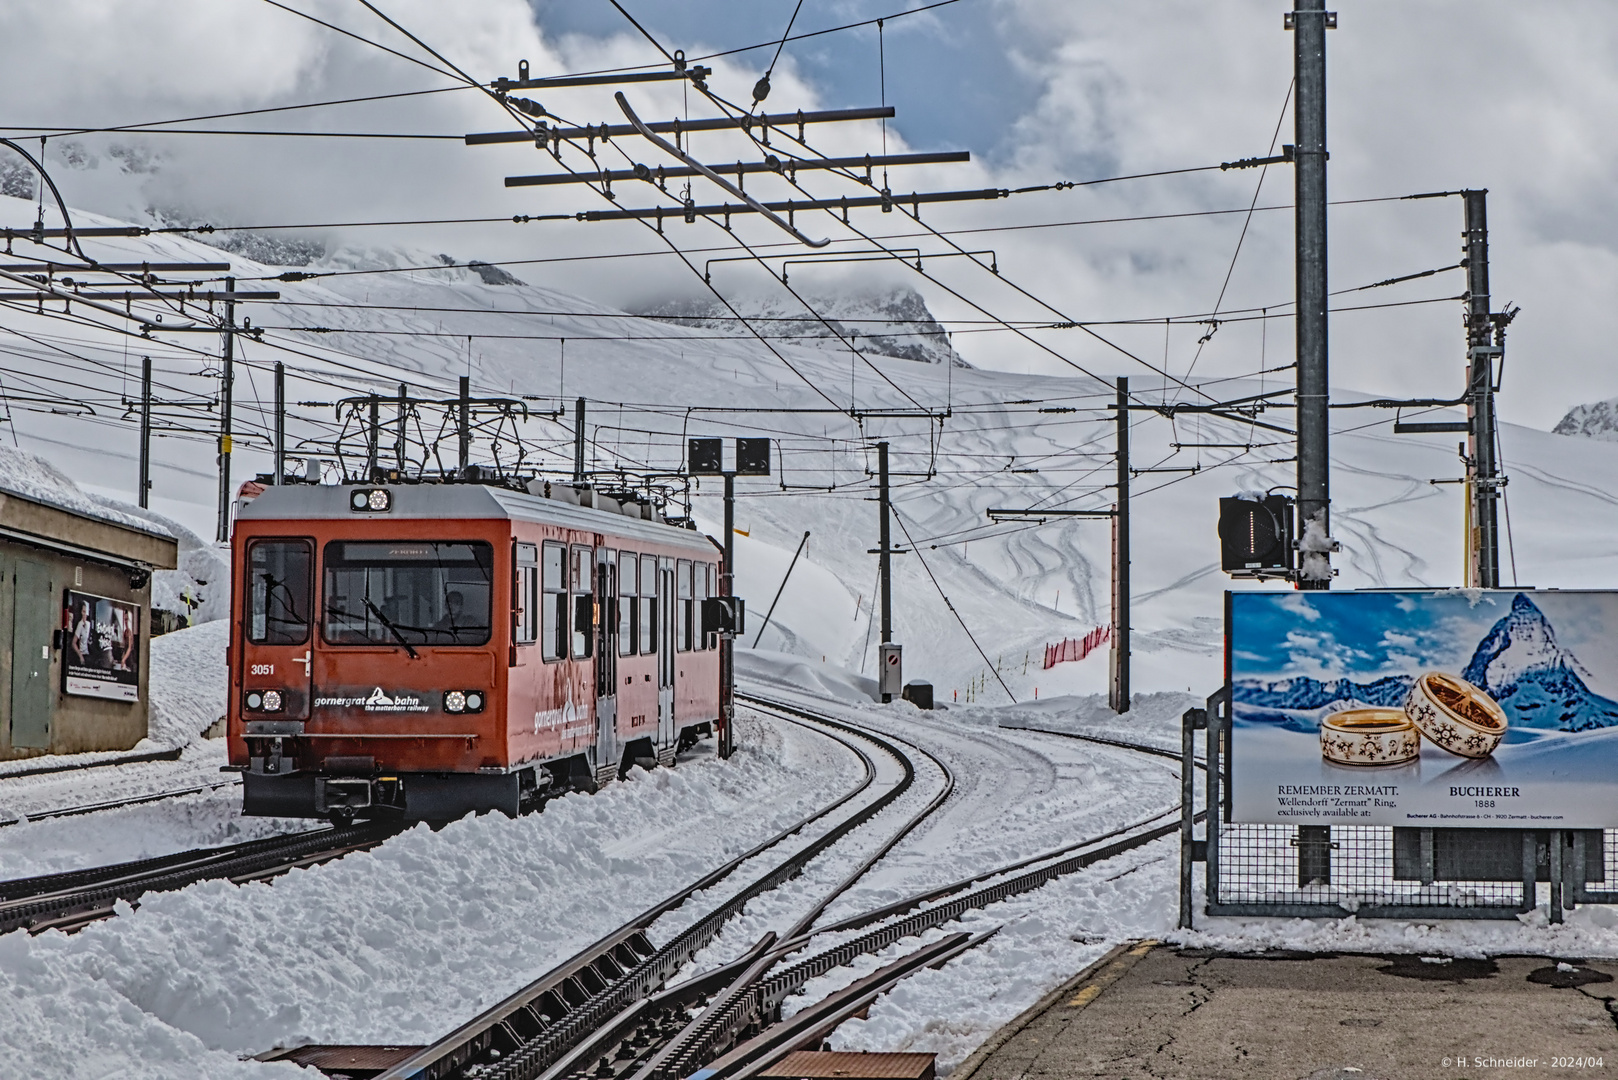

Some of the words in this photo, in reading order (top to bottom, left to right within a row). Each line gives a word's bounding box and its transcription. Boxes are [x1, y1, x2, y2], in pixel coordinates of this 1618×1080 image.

[251, 664, 275, 675] 3051
[314, 696, 366, 707] gornergrat
[394, 696, 419, 706] bahn
[407, 705, 430, 713] railway
[1278, 786, 1341, 796] REMEMBER
[1344, 786, 1399, 796] ZERMATT.
[1450, 786, 1520, 797] BUCHERER
[1278, 797, 1328, 806] Wellendorff
[1374, 798, 1396, 808] Ring,
[1474, 800, 1496, 808] 1888
[1278, 808, 1321, 818] exclusively
[1322, 808, 1358, 817] available
[1360, 809, 1371, 817] at:
